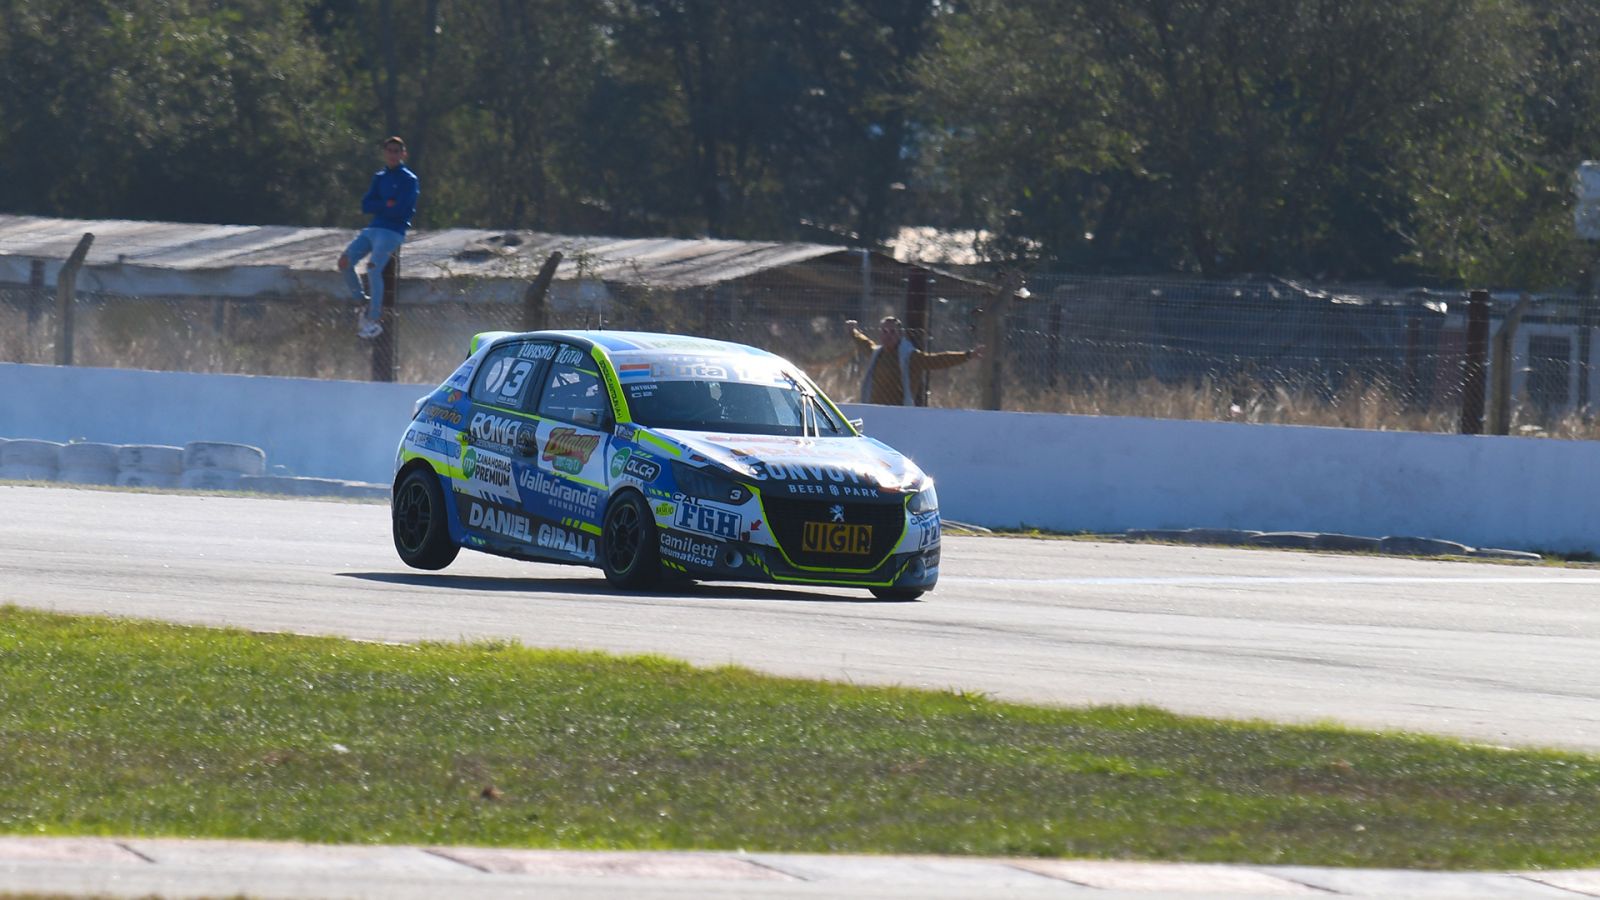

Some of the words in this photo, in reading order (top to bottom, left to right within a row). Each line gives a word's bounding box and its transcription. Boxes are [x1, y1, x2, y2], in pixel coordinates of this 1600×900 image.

[500, 361, 533, 397] 3
[474, 464, 511, 487] PREMIUM
[519, 470, 598, 509] ValleGrande
[729, 489, 741, 500] 3
[788, 484, 824, 494] BEER
[843, 487, 879, 498] PARK
[468, 502, 532, 543] DANIEL
[537, 523, 596, 561] GIRALA
[678, 502, 739, 538] FGH
[659, 545, 714, 567] neumaticos
[660, 533, 718, 559] camiletti
